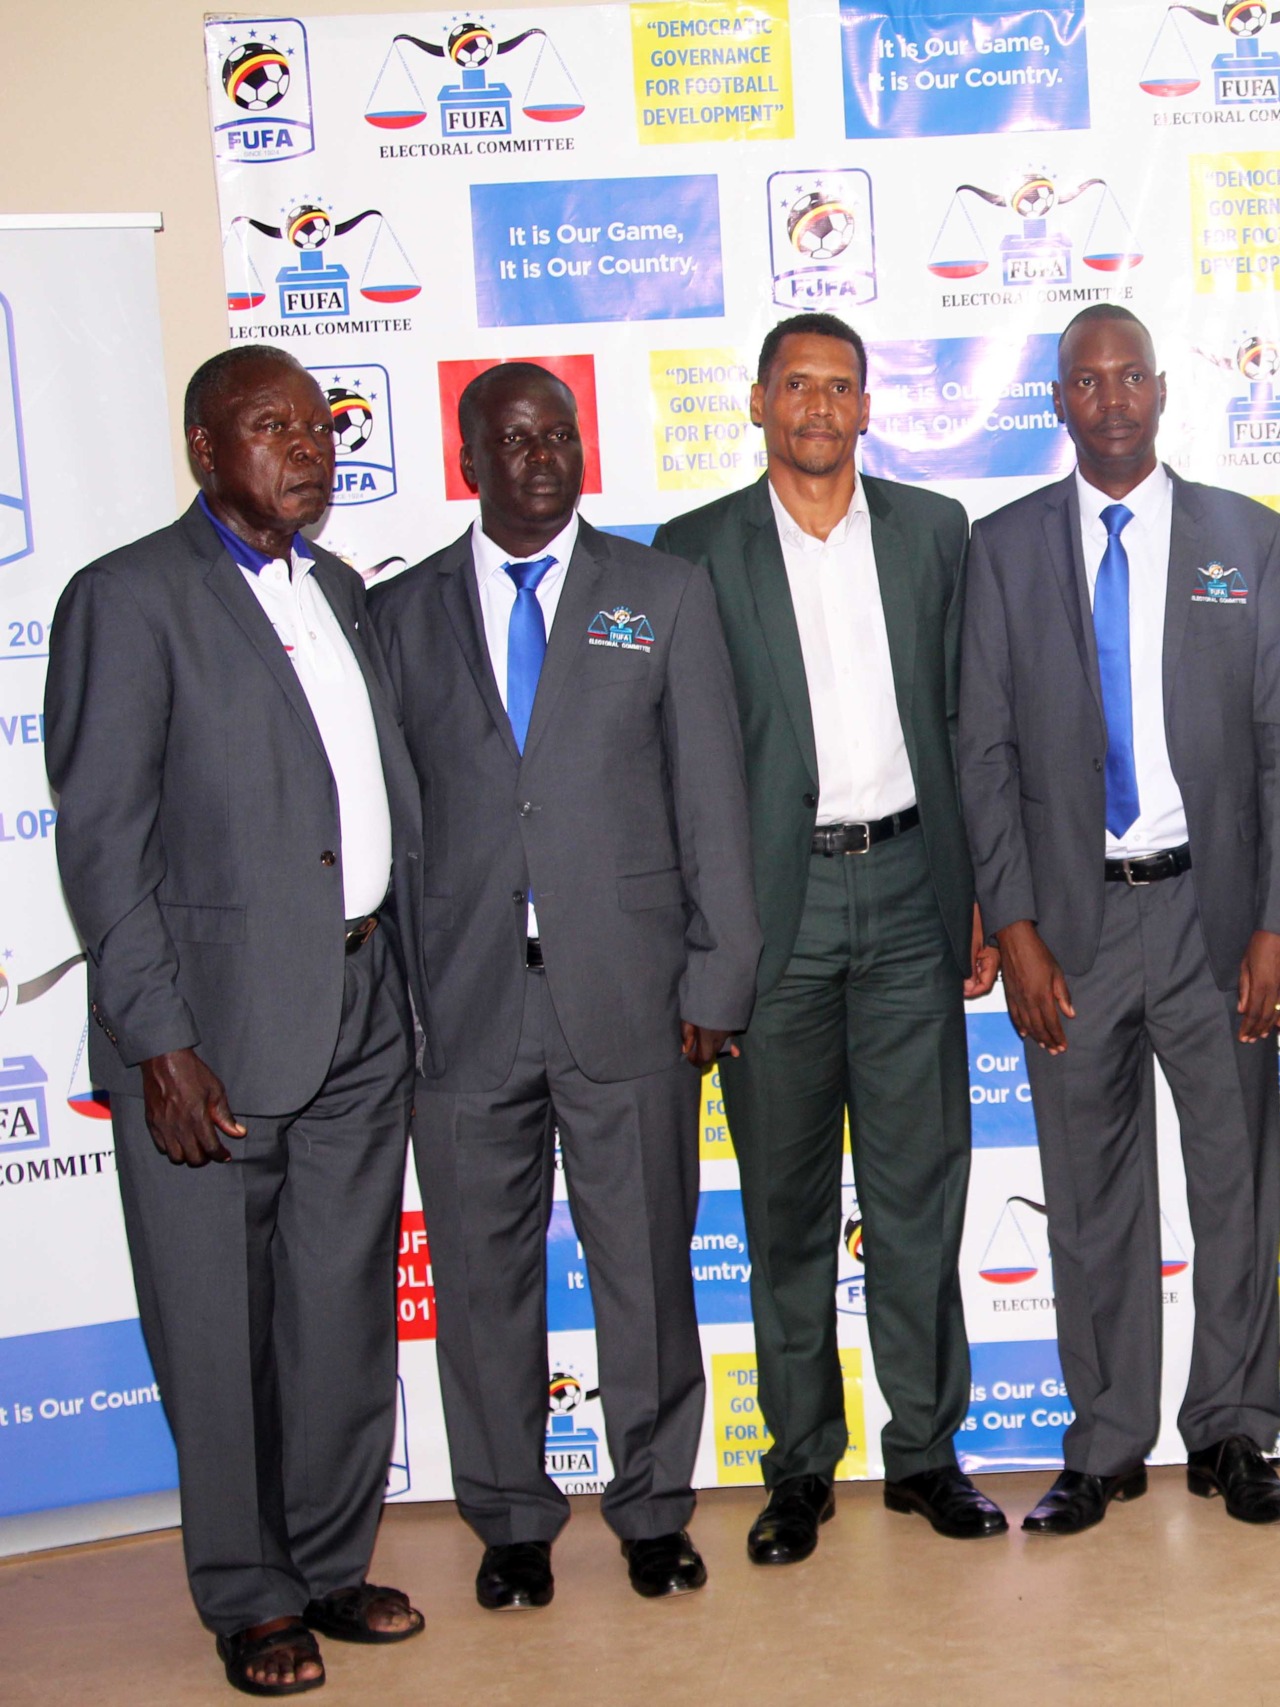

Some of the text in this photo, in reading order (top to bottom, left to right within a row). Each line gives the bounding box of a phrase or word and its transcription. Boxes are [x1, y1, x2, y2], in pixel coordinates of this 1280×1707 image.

[646, 18, 773, 38] “DEMOCRATIC
[651, 46, 771, 67] GOVERNANCE
[879, 35, 1050, 58] It is Our Game,
[646, 74, 778, 97] FOR FOOTBALL
[891, 71, 908, 91] is
[915, 71, 959, 90] Our
[965, 66, 1062, 88] Country.
[1222, 79, 1277, 97] FUFA
[447, 110, 504, 131] FUFA
[643, 104, 784, 127] DEVELOPMENT”
[228, 129, 293, 149] FUFA
[379, 137, 575, 159] ELECTORAL COMMITTEE
[509, 220, 684, 246] It is Our Game,
[1204, 229, 1237, 246] FOR
[500, 253, 698, 280] It is Our Country.
[287, 292, 342, 310] FUFA
[942, 287, 1133, 307] ELECTORA OMMITTE
[230, 319, 412, 339] LECTORAL COMMITTEE
[666, 366, 754, 384] “DEMOCR
[942, 382, 973, 400] Ou
[670, 395, 750, 413] GOVERN
[933, 415, 969, 431] Ou
[984, 411, 1058, 431] Countr
[665, 423, 749, 442] FOR FOOT
[663, 450, 768, 471] DEVELOPE
[332, 473, 376, 492] UFA
[8, 620, 49, 648] 20
[977, 1054, 1019, 1071] Our
[971, 1085, 1009, 1104] Our
[707, 1101, 725, 1115] FO
[0, 1106, 36, 1139] FA
[568, 1263, 751, 1289] It untry
[398, 1299, 436, 1321] 01
[993, 1298, 1057, 1312] ELECTO
[992, 1381, 1037, 1400] Our
[15, 1404, 33, 1424] is
[39, 1396, 85, 1419] Our
[90, 1382, 161, 1412] Count
[983, 1412, 1026, 1430] Our
[726, 1425, 757, 1440] FOR
